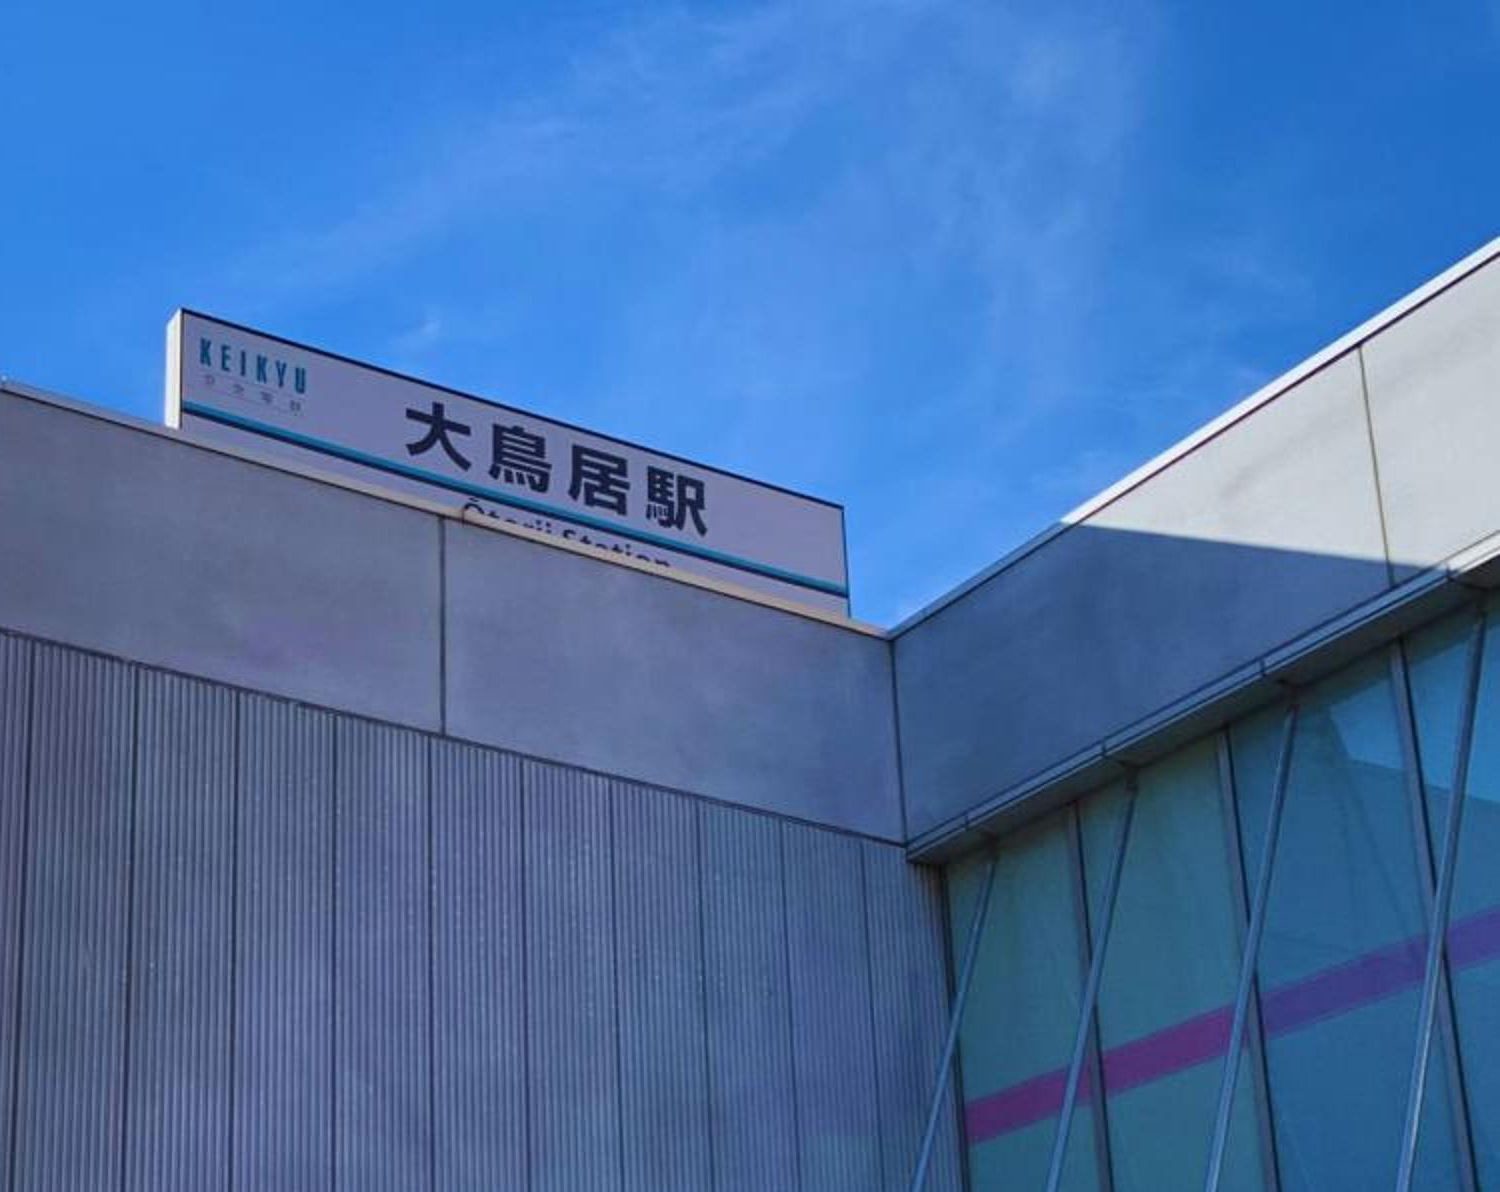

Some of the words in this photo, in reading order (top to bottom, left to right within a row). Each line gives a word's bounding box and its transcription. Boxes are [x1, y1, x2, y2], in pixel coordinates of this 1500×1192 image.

[199, 337, 306, 394] KEIKYU
[404, 400, 709, 536] 大鳥居駅
